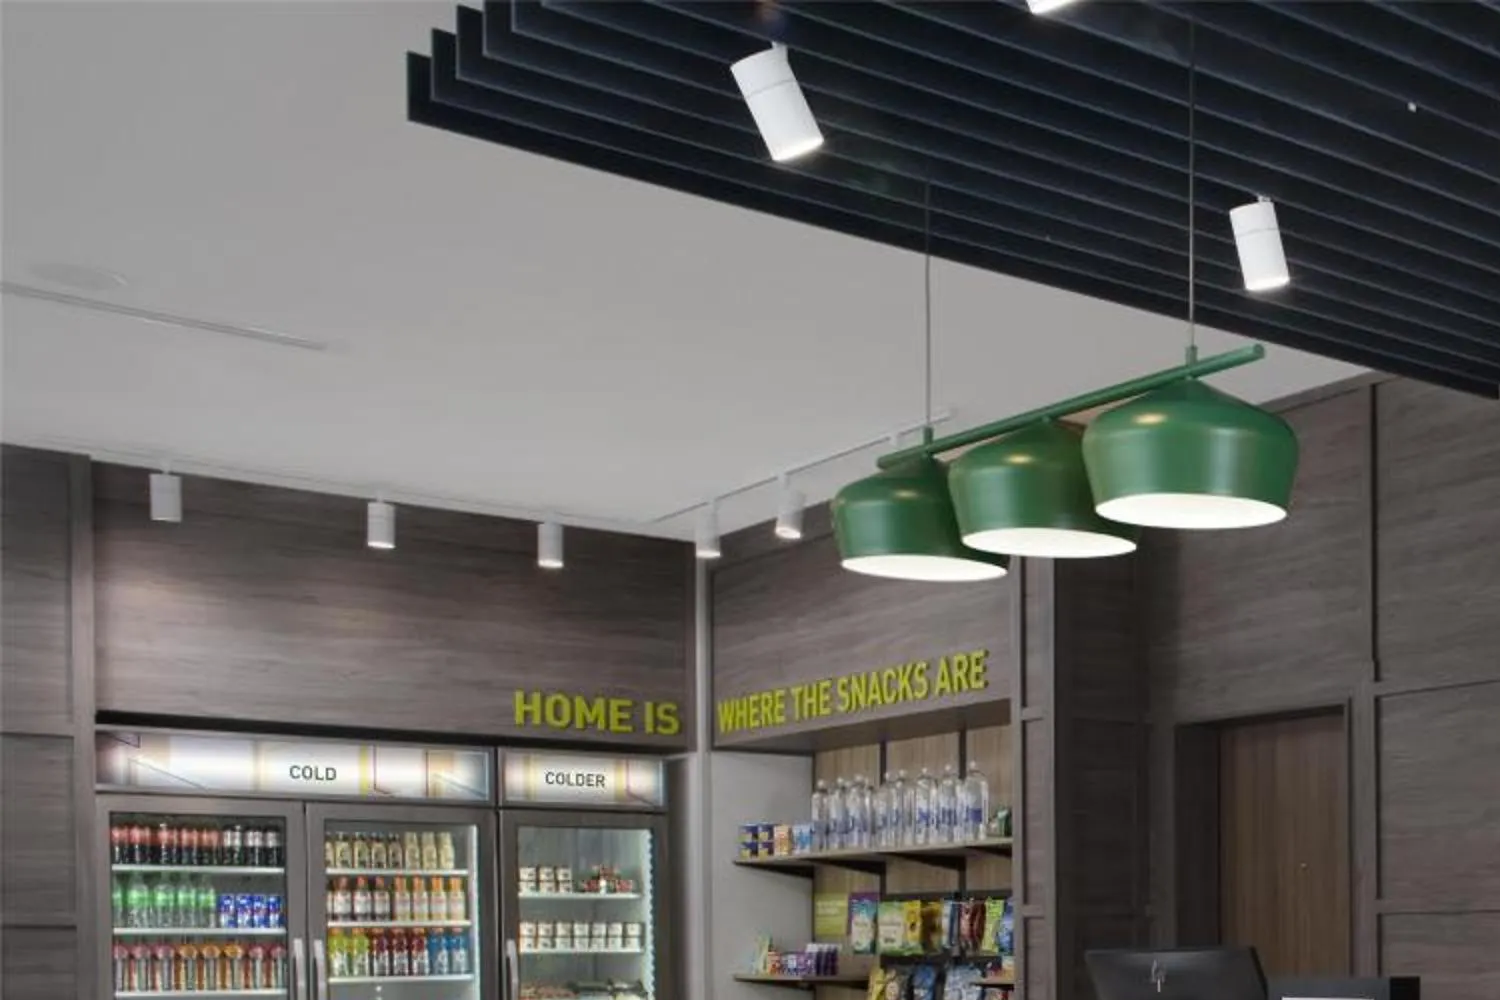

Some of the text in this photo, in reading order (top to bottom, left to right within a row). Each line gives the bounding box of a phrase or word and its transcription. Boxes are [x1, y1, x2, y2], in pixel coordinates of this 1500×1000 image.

[717, 649, 988, 732] WHERE THE SNACKS ARE
[514, 688, 680, 735] HOME IS
[289, 765, 337, 781] COLD
[545, 771, 606, 787] COLDER
